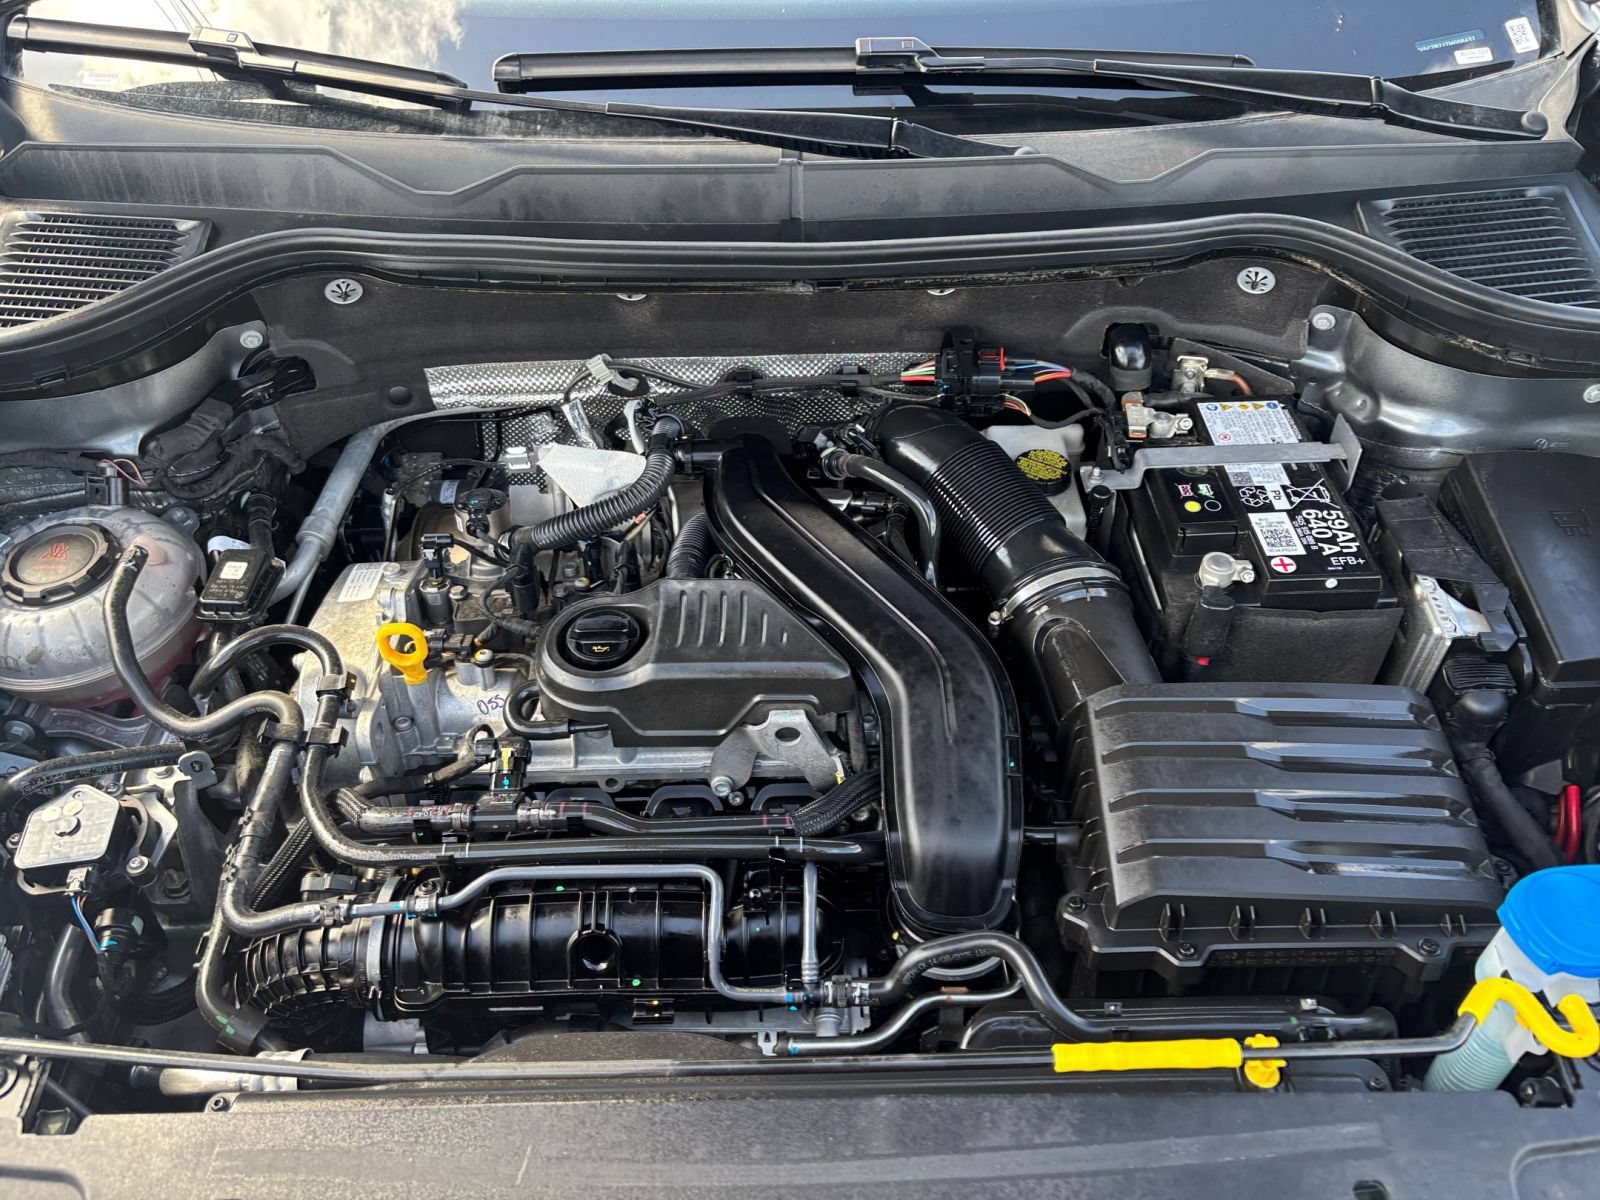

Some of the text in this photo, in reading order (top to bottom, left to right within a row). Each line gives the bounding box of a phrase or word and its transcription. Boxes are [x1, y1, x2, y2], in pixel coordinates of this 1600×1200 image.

[1271, 490, 1282, 500] Pb
[1302, 509, 1333, 538] 640
[1318, 542, 1341, 556] A
[1322, 510, 1360, 553] 59Ah
[1330, 556, 1366, 565] EFB+
